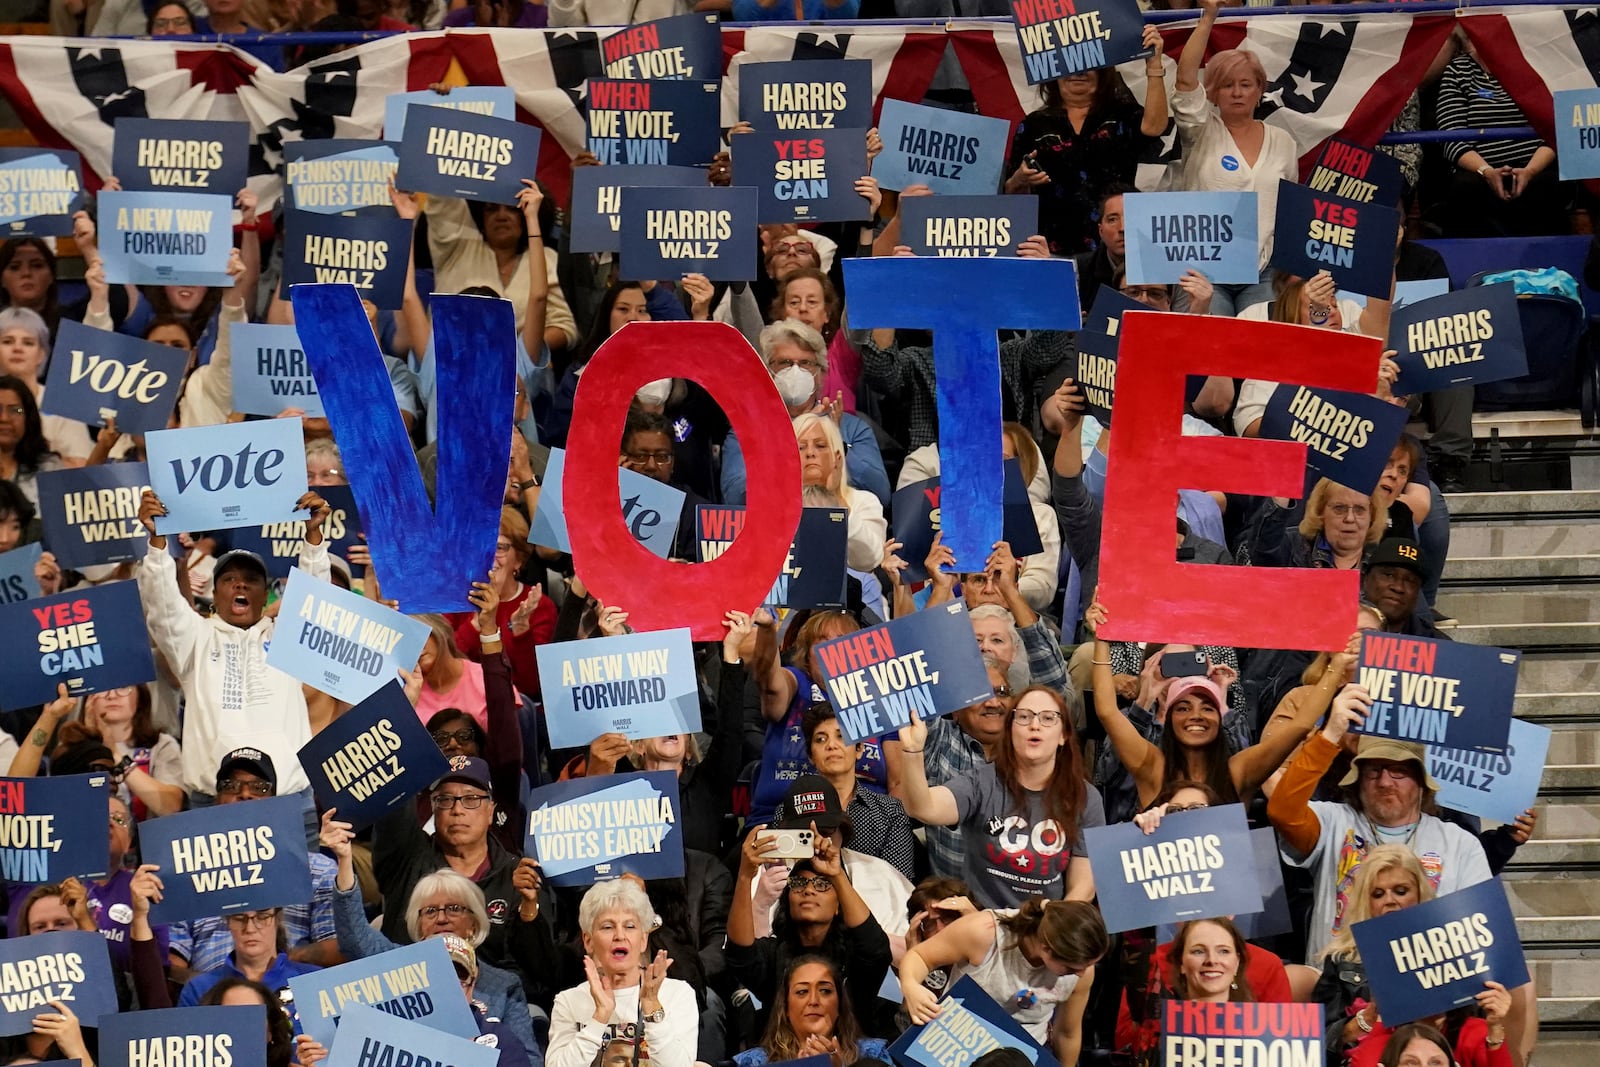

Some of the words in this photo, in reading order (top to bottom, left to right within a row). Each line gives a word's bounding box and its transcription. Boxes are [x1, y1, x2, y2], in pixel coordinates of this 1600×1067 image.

[605, 24, 659, 62] WHEN
[1020, 23, 1054, 54] WE
[1055, 11, 1112, 46] VOTE,
[606, 55, 634, 79] WE
[638, 47, 693, 77] VOTE,
[1026, 50, 1061, 82] WE
[1065, 39, 1106, 74] WIN
[590, 82, 650, 110] WHEN
[763, 82, 847, 112] HARRIS
[589, 110, 621, 138] WE
[624, 111, 680, 143] VOTE,
[776, 113, 835, 130] WALZ
[138, 139, 223, 170] HARRIS
[426, 127, 514, 166] HARRIS
[589, 138, 621, 165] WE
[625, 138, 668, 165] WIN
[773, 139, 826, 160] YES
[899, 125, 980, 165] HARRIS
[1322, 141, 1373, 178] WHEN
[150, 169, 208, 187] WALZ
[287, 160, 399, 185] PENNSYLVAN
[437, 158, 497, 181] WALZ
[775, 159, 826, 180] SHE
[907, 156, 962, 180] WALZ
[20, 192, 70, 215] EARLY
[297, 183, 345, 206] VOTES
[352, 185, 393, 207] EARL
[774, 180, 829, 201] CAN
[116, 208, 128, 231] A
[133, 208, 172, 231] NEW
[175, 210, 213, 233] WAY
[647, 210, 731, 240] HARRIS
[1152, 214, 1233, 243] HARRIS
[1313, 198, 1358, 226] YES
[124, 231, 207, 256] FORWARD
[926, 217, 1011, 247] HARRIS
[1308, 219, 1356, 248] SHE
[304, 235, 388, 270] HARRIS
[659, 242, 719, 259] WALZ
[1165, 245, 1222, 262] WALZ
[1305, 240, 1354, 269] CAN
[314, 266, 375, 289] WALZ
[1408, 309, 1494, 353] HARRIS
[1078, 352, 1117, 389] HARR
[1423, 343, 1485, 370] WALZ
[69, 350, 168, 404] vote
[271, 379, 317, 396] WAL
[1085, 386, 1113, 409] WAL
[1288, 386, 1375, 449] HARRIS
[1290, 420, 1350, 461] WALZ
[169, 442, 284, 495] vote
[32, 599, 93, 630] YES
[299, 594, 313, 620] A
[315, 599, 360, 638] NEW
[359, 616, 404, 656] WAY
[37, 621, 98, 653] SHE
[299, 621, 383, 677] FORWARD
[818, 627, 896, 678] WHEN
[40, 644, 104, 677] CAN
[563, 660, 576, 687] A
[579, 654, 623, 684] NEW
[627, 648, 669, 678] WAY
[1364, 635, 1437, 675] WHEN
[572, 677, 666, 712] FORWARD
[829, 669, 873, 710] WE
[869, 650, 940, 697] VOTE,
[1360, 667, 1396, 703] WE
[1401, 674, 1465, 718] VOTE,
[839, 705, 884, 742] WE
[880, 684, 937, 729] WIN
[1398, 703, 1450, 744] WIN
[321, 718, 402, 793] HARRIS
[348, 755, 406, 803] WALZ
[1431, 759, 1495, 793] WALZ
[0, 781, 25, 814] EN
[793, 794, 825, 806] HARRIS
[794, 803, 817, 815] WALZ
[530, 797, 675, 836] PENNSYLVANIA
[0, 815, 62, 852] VOTE,
[171, 826, 276, 874] HARRIS
[540, 830, 600, 861] VOTES
[605, 825, 664, 857] EARLY
[999, 816, 1067, 856] GO
[1, 849, 48, 882] WIN
[1120, 834, 1224, 884] HARRIS
[191, 864, 264, 893] WALZ
[1143, 872, 1215, 900] WALZ
[1389, 913, 1494, 973] HARRIS
[0, 953, 85, 994] ARRIS
[1415, 952, 1490, 990] WALZ
[3, 983, 75, 1012] WALZ
[318, 990, 336, 1018] A
[334, 973, 384, 1008] NEW
[382, 961, 430, 997] WAY
[1166, 1000, 1321, 1037] FREEDOM
[128, 1034, 232, 1067] HARRIS
[1166, 1036, 1328, 1067] FREEDOM
